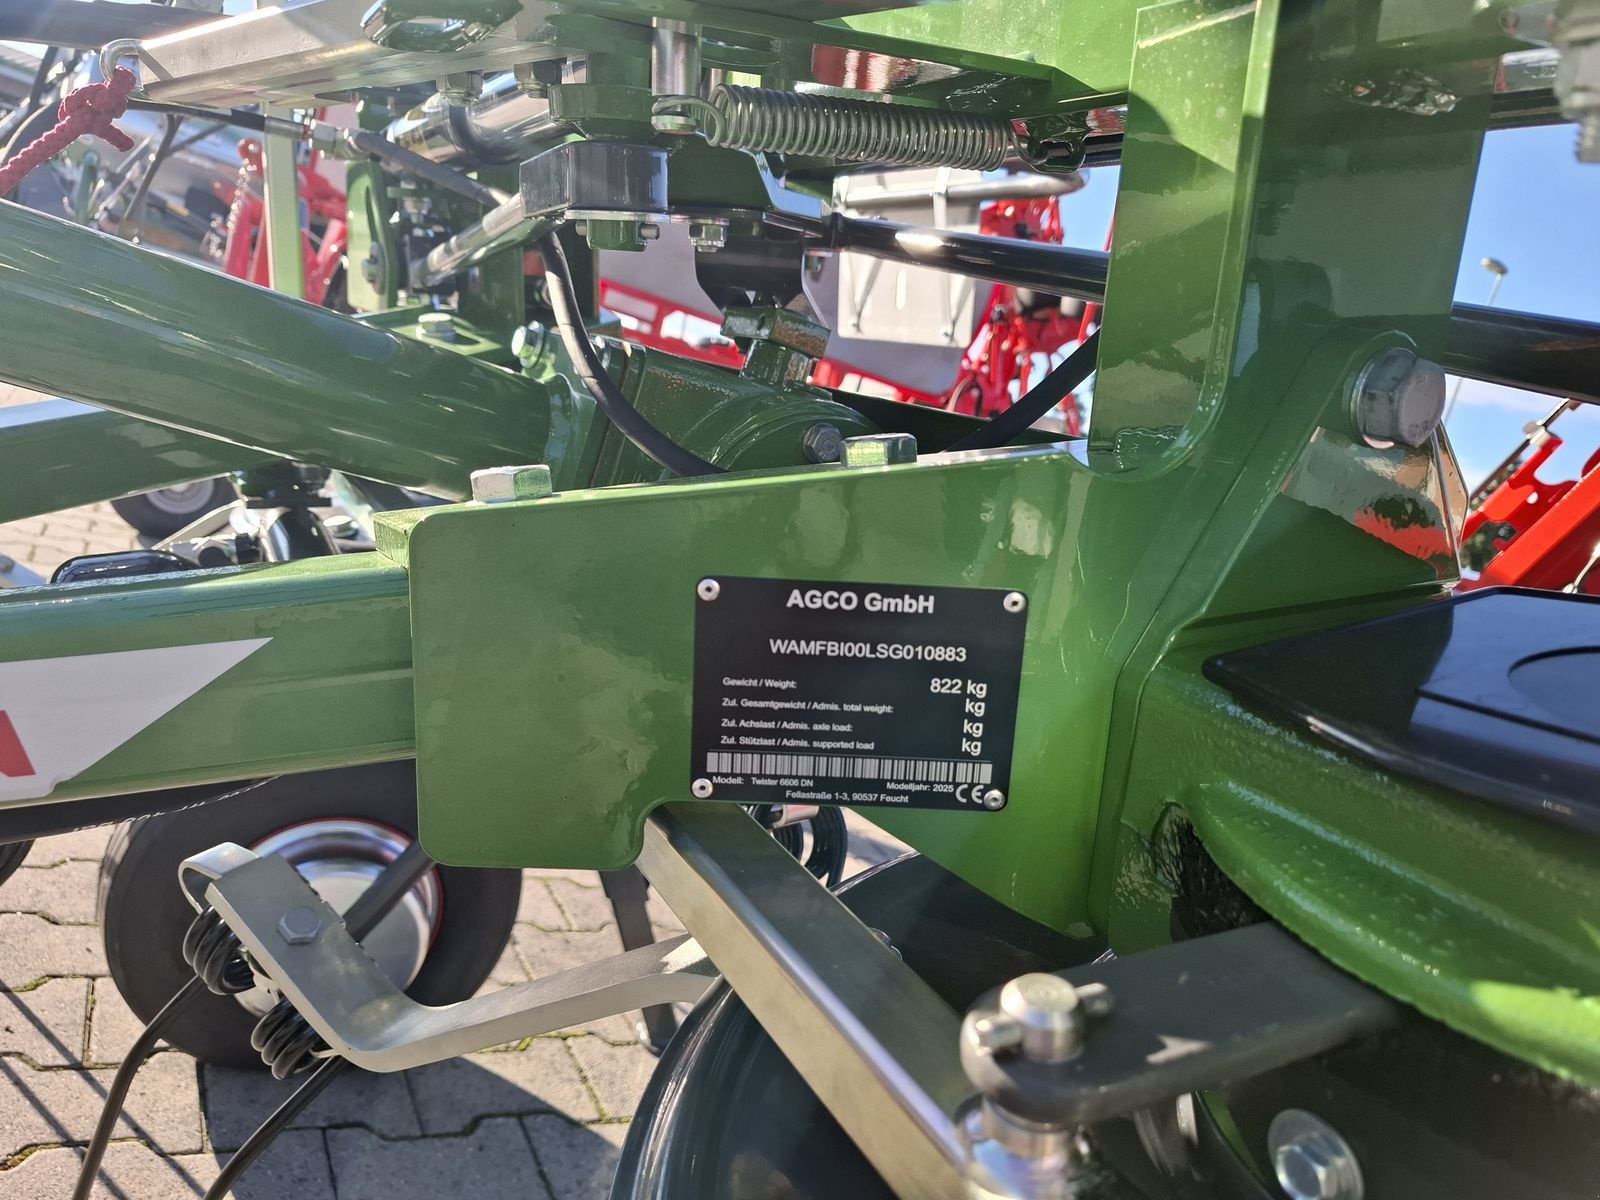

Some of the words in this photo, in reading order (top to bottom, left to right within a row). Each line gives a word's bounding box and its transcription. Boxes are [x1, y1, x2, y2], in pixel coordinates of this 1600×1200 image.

[786, 589, 858, 611] AGCO
[864, 592, 935, 614] GmbH
[722, 677, 758, 687] Gewicht
[764, 679, 797, 690] Weight:
[930, 677, 962, 694] 822
[966, 679, 987, 698] kg
[722, 697, 738, 707] Zul.
[740, 698, 806, 710] Gesamtgewicht
[812, 701, 841, 711] Admis.
[843, 702, 861, 712] total
[863, 704, 894, 715] weight:
[965, 698, 986, 717] kg
[721, 718, 737, 727] Zul.
[738, 719, 775, 729] Achslast
[781, 721, 810, 730] Admis.
[812, 722, 831, 731] axle
[832, 723, 853, 732] load:
[963, 718, 984, 738] kg
[720, 735, 737, 745] Zul.
[738, 736, 775, 746] Stützlast
[781, 738, 810, 747] Admis.
[812, 740, 855, 750] supported
[856, 741, 875, 750] load
[961, 737, 982, 756] kg
[712, 775, 744, 785] Modell:
[751, 777, 778, 786] Twister
[800, 778, 814, 787] DN
[886, 782, 931, 793] Modelljahr:
[932, 783, 954, 793] 2025
[785, 790, 832, 800] Fellastraße
[852, 792, 878, 802] 90537
[879, 793, 909, 803] Feucht
